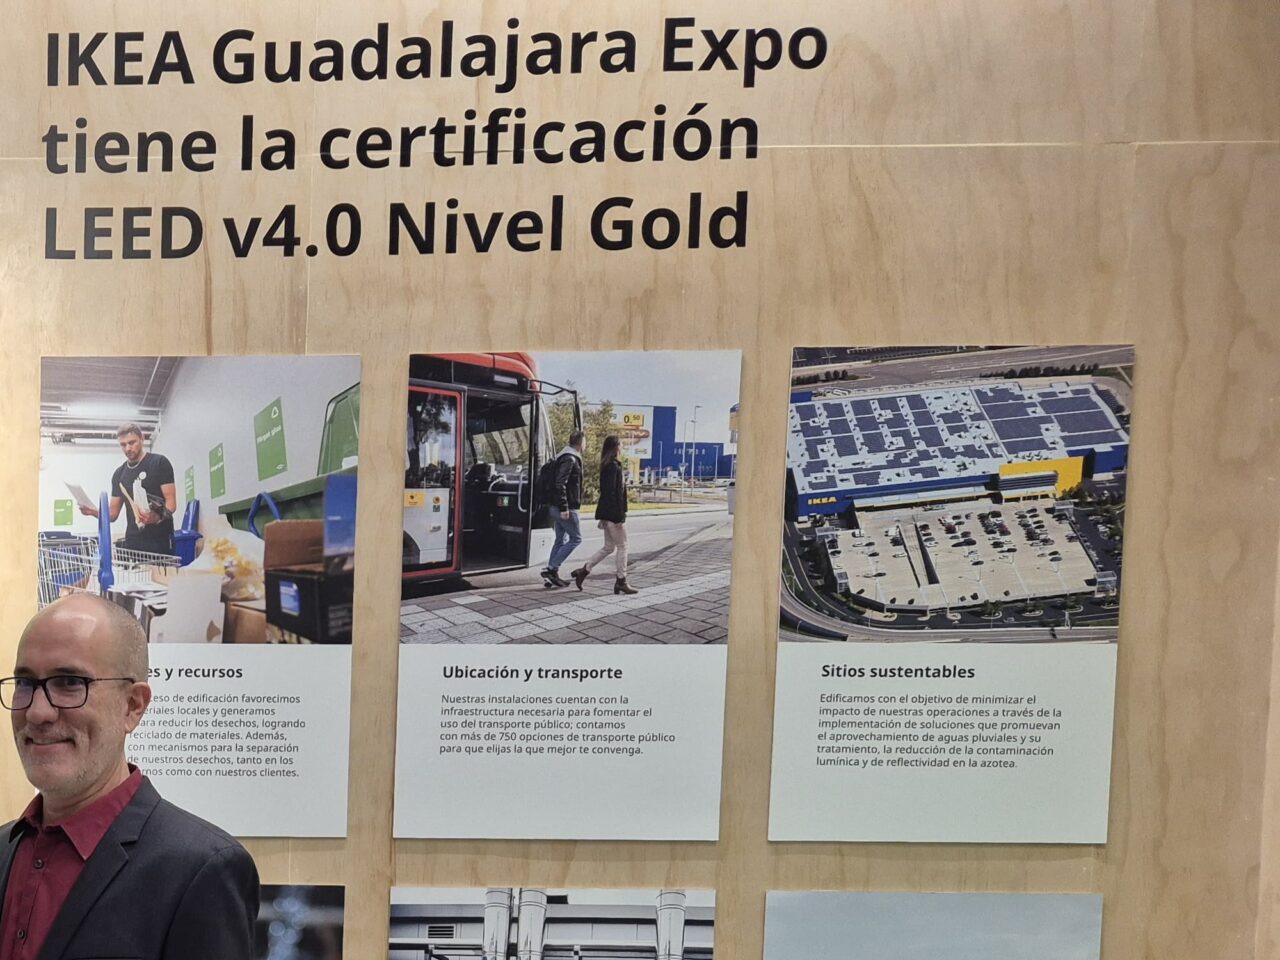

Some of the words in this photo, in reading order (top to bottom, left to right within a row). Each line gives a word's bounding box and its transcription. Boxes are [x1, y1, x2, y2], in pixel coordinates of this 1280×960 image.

[47, 31, 194, 86] IKEA
[212, 18, 636, 93] Guadalajara
[662, 17, 827, 87] Expo
[42, 118, 216, 174] tiene
[241, 115, 295, 171] la
[319, 103, 758, 170] certificación
[45, 207, 203, 260] LEED
[222, 203, 361, 258] v4.0
[388, 195, 563, 255] Nivel
[590, 192, 747, 251] Gold
[165, 668, 173, 681] y
[178, 668, 242, 678] recursos
[443, 665, 518, 679] Ubicación
[524, 669, 533, 682] y
[537, 667, 622, 682] transporte
[821, 664, 865, 677] Sitios
[870, 665, 974, 678] sustentables
[442, 694, 485, 703] Nuestras
[488, 695, 552, 704] instalaciones
[555, 696, 596, 704] cuentan
[620, 695, 628, 704] la
[820, 693, 875, 703] Edificamos
[899, 694, 908, 703] el
[911, 694, 952, 706] objetivo
[955, 694, 968, 704] de
[971, 695, 1024, 704] minimizar
[1026, 695, 1036, 704] el
[441, 707, 514, 716] infraestructura
[517, 708, 564, 716] necesaria
[568, 709, 590, 718] para
[593, 707, 640, 717] fomentar
[643, 708, 652, 716] el
[818, 719, 901, 730] implementación
[904, 720, 917, 729] de
[920, 720, 975, 729] soluciones
[977, 722, 997, 731] que
[1000, 722, 1060, 732] promuevan
[129, 730, 172, 739] reciclado
[174, 730, 187, 739] de
[190, 731, 242, 740] materiales.
[245, 731, 286, 741] Además,
[460, 731, 481, 741] más
[484, 732, 496, 741] de
[499, 732, 516, 741] 750
[519, 732, 564, 743] opciones
[566, 732, 579, 741] de
[582, 734, 635, 744] transporte
[638, 733, 675, 744] público
[148, 743, 208, 752] mecanismos
[210, 745, 232, 754] para
[235, 743, 243, 752] la
[246, 744, 298, 754] separación
[127, 755, 139, 764] de
[142, 756, 183, 764] nuestros
[186, 755, 233, 765] desechos,
[280, 756, 293, 765] los
